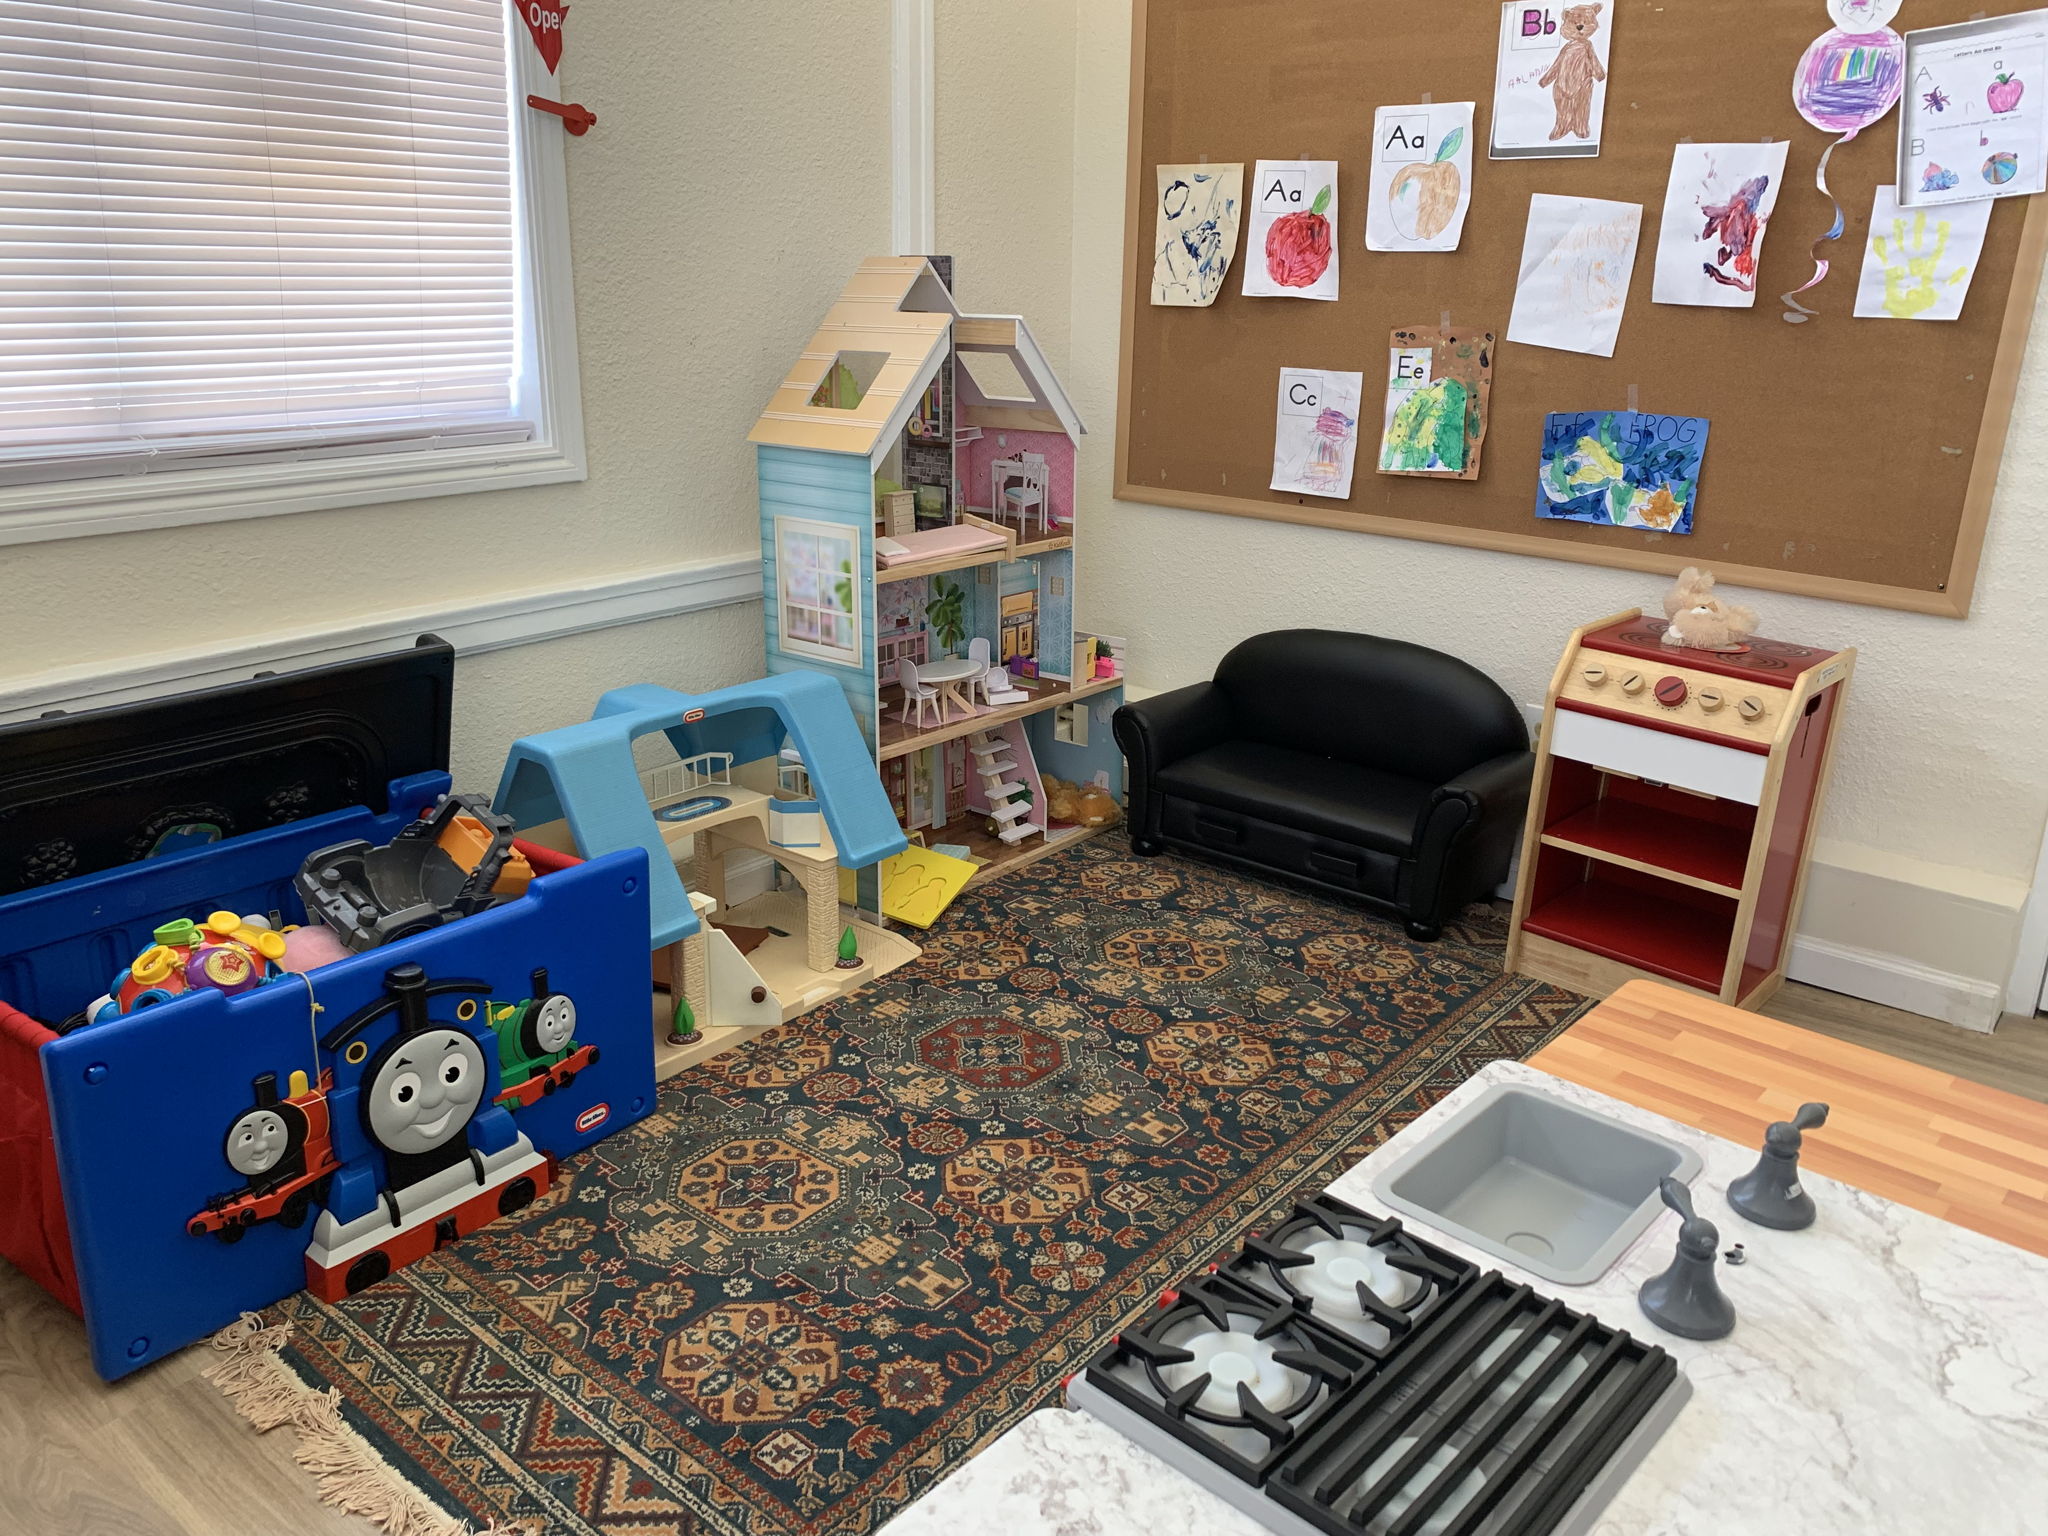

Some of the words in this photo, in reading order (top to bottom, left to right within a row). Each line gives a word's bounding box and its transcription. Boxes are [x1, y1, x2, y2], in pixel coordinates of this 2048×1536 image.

[530, 2, 562, 34] Ope
[1521, 8, 1557, 37] Bb
[1385, 125, 1425, 150] Aa
[1264, 179, 1302, 203] Aa
[1397, 356, 1424, 379] Ee
[1289, 383, 1317, 407] Cc
[1629, 413, 1698, 443] FROG
